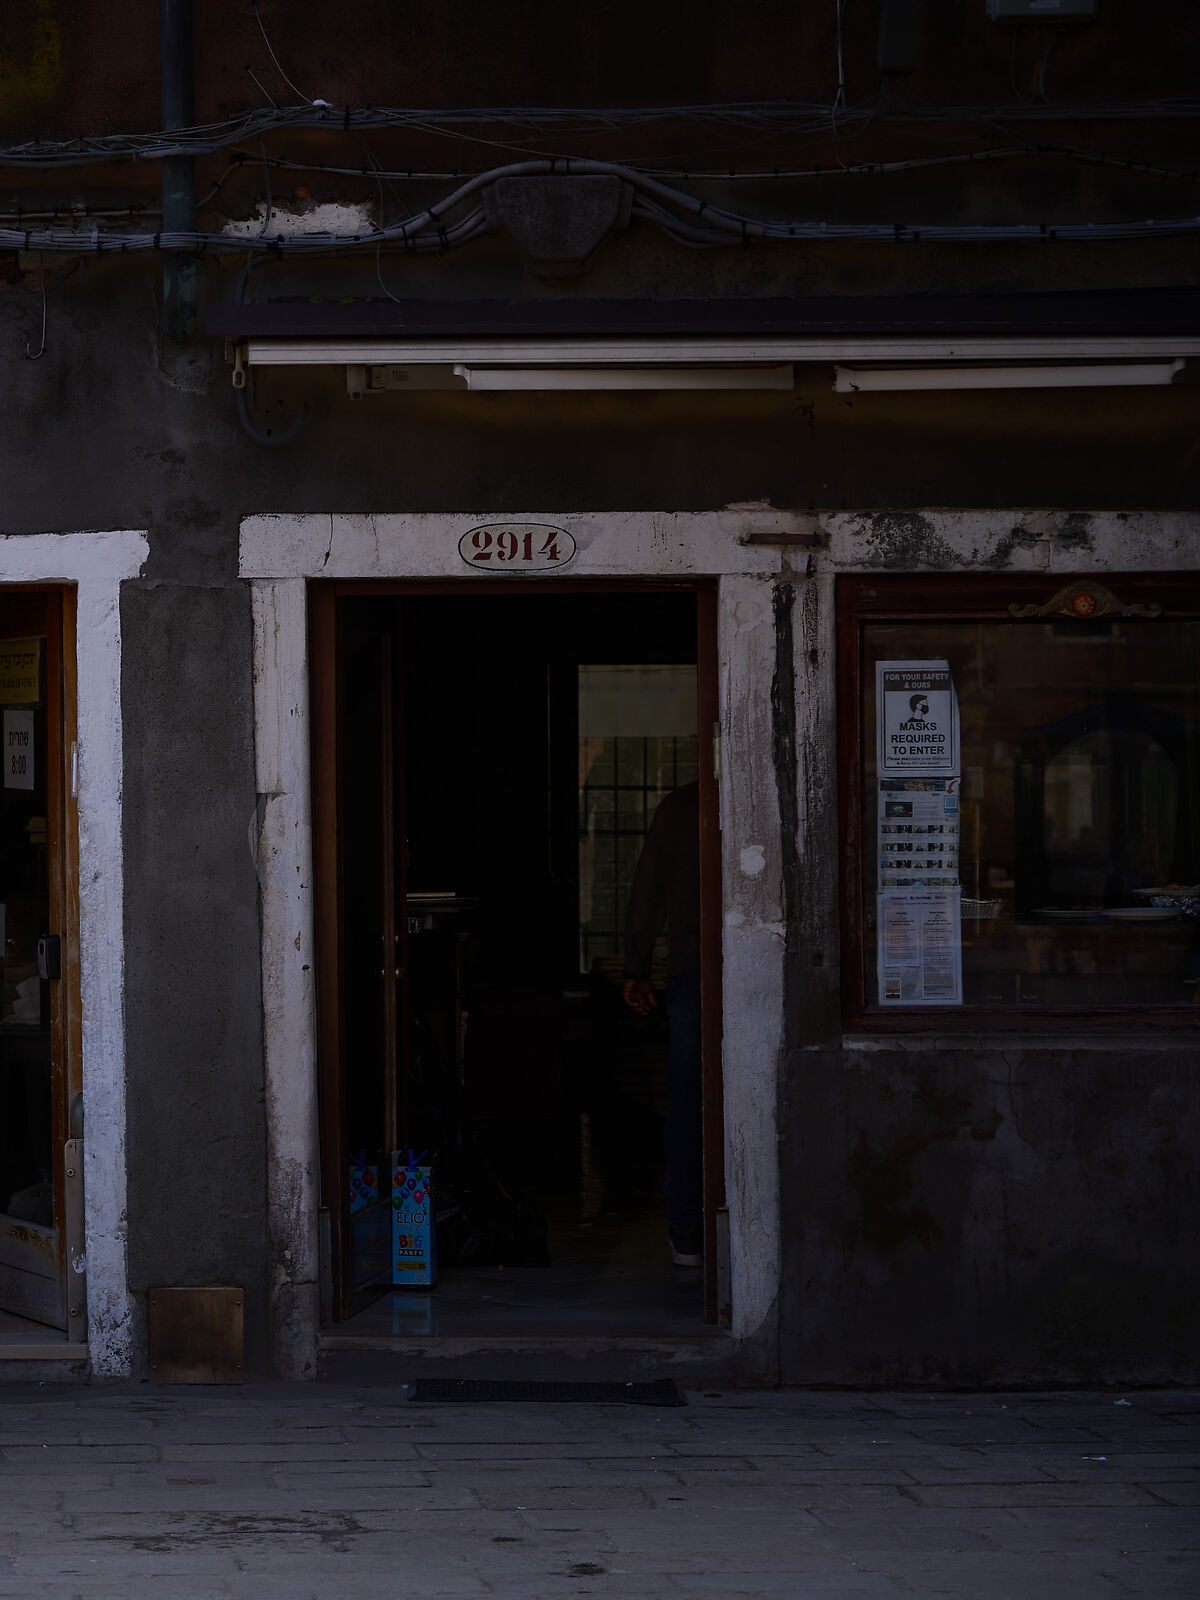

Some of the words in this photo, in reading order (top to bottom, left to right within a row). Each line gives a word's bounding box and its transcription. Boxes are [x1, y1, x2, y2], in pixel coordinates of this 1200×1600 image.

[472, 531, 561, 561] 2914
[899, 722, 937, 731] MASKS
[8, 731, 29, 747] שחרית
[891, 734, 946, 744] REQUIRED
[892, 746, 907, 755] TO
[909, 746, 945, 755] ENTER
[11, 755, 27, 776] 8:00
